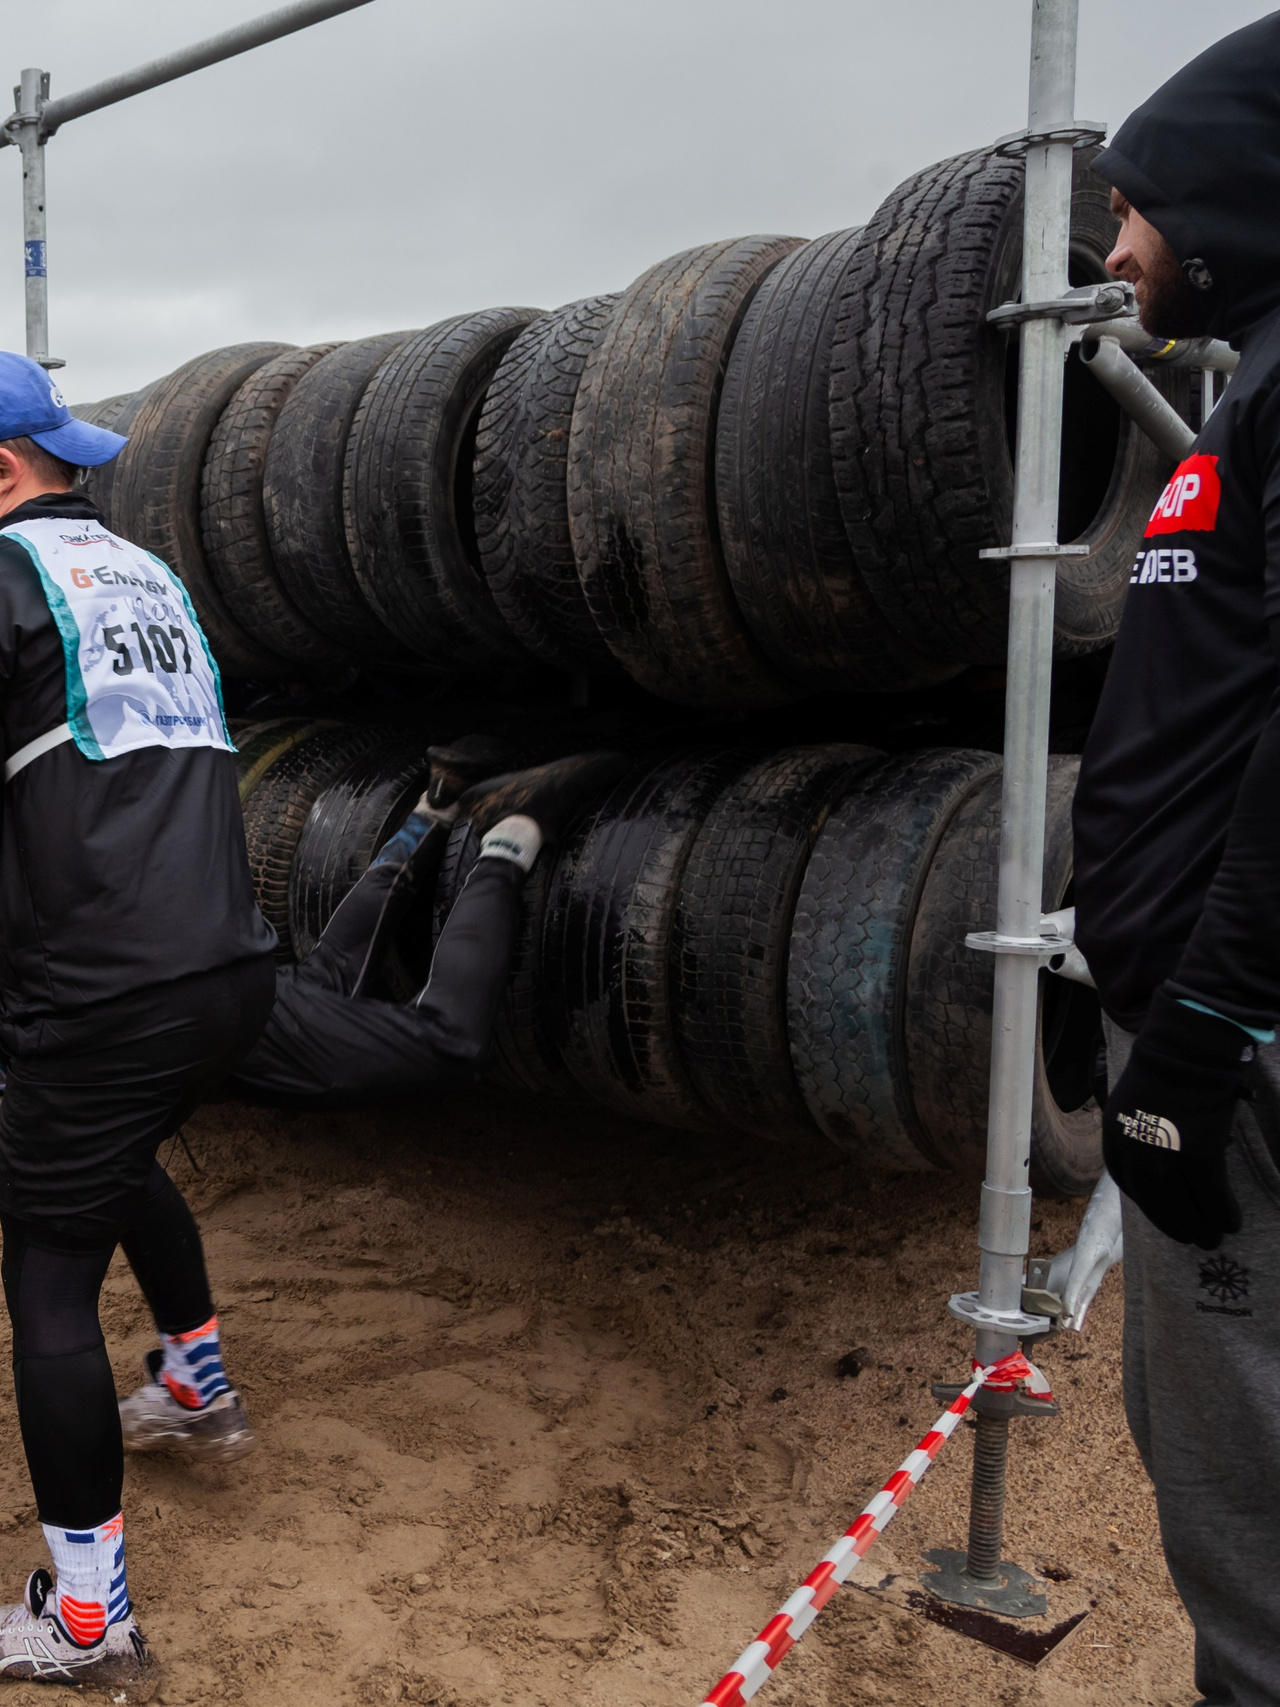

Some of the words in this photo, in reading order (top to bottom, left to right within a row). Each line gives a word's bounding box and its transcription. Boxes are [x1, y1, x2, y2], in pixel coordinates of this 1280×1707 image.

[102, 621, 192, 677] 5107
[1116, 1112, 1158, 1136] NORTH
[1135, 1109, 1160, 1126] THE
[1123, 1125, 1155, 1145] FACE
